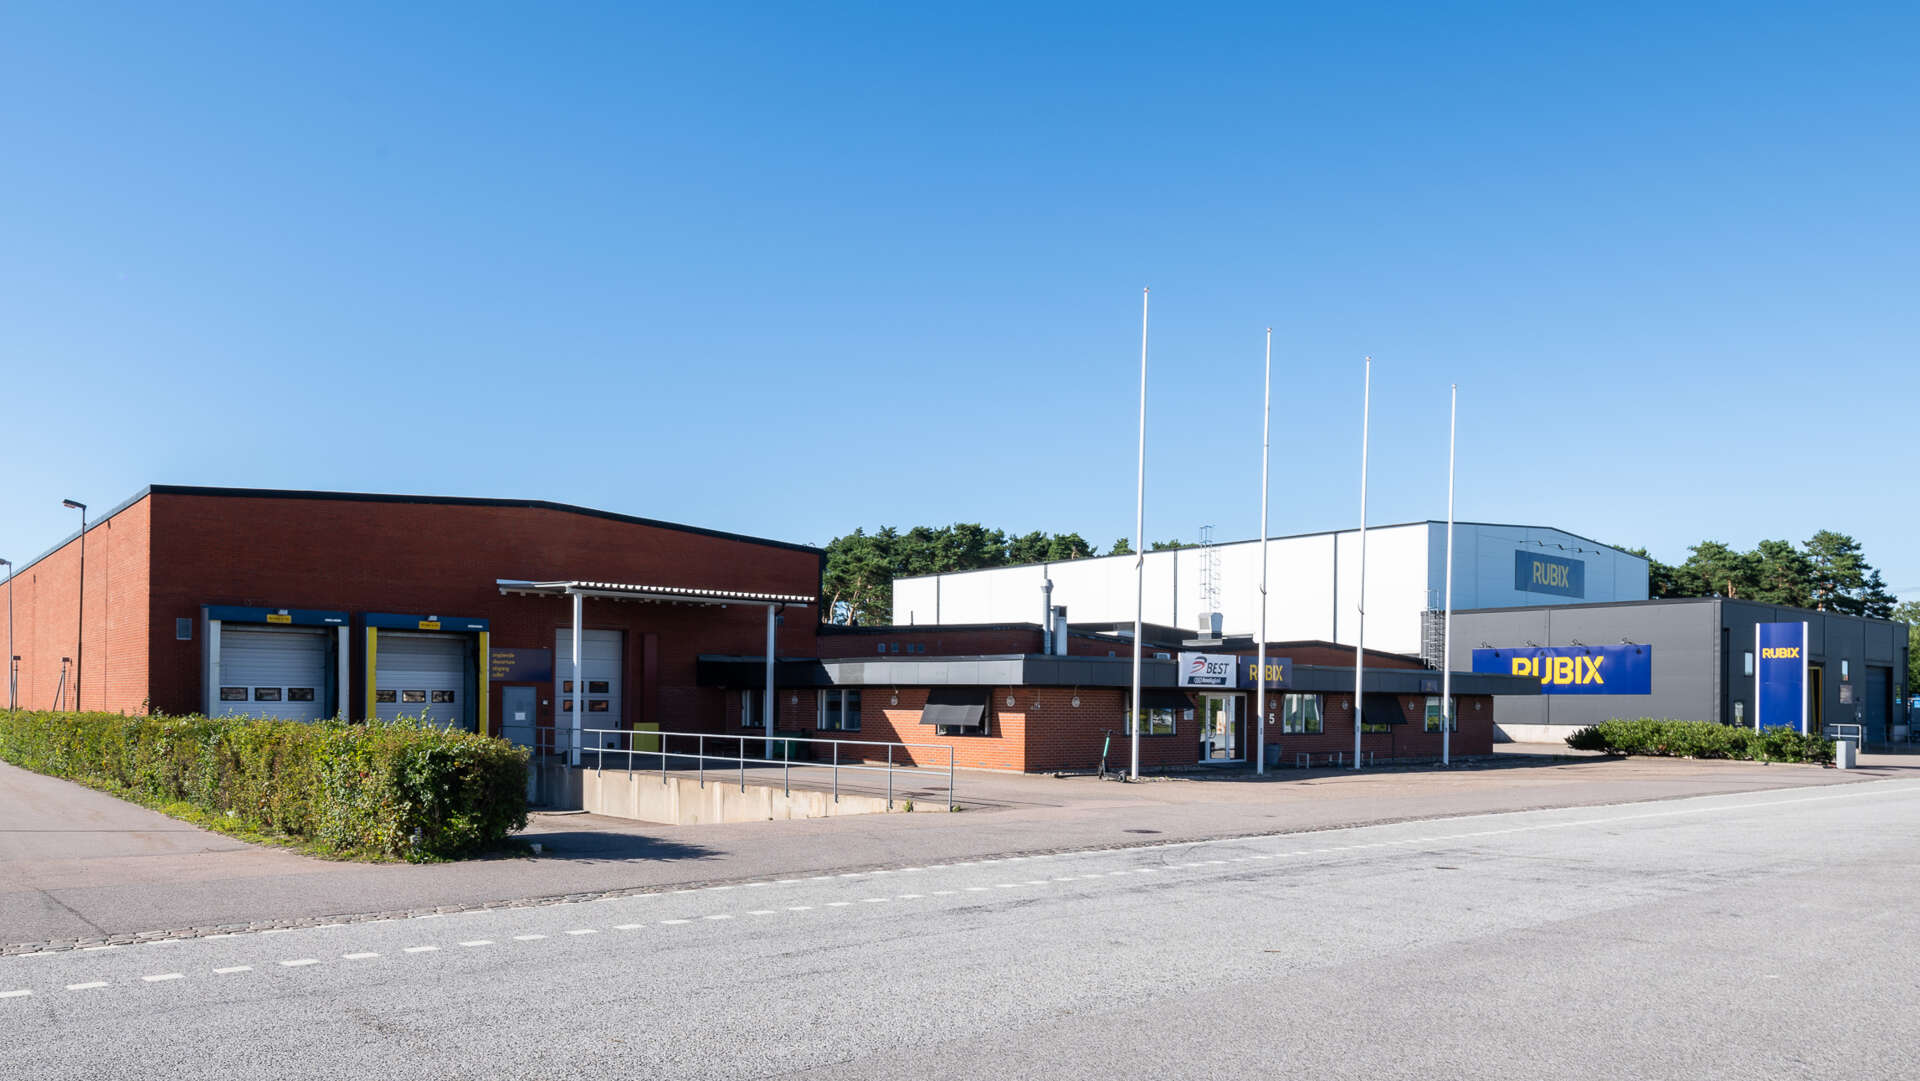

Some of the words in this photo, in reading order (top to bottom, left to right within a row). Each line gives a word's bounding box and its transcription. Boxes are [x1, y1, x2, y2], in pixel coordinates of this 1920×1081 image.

[1533, 561, 1569, 588] RUBIX
[1762, 647, 1800, 659] RUBIX
[1206, 662, 1230, 675] BEST
[1249, 664, 1283, 681] RBIX
[1269, 713, 1275, 725] 5
